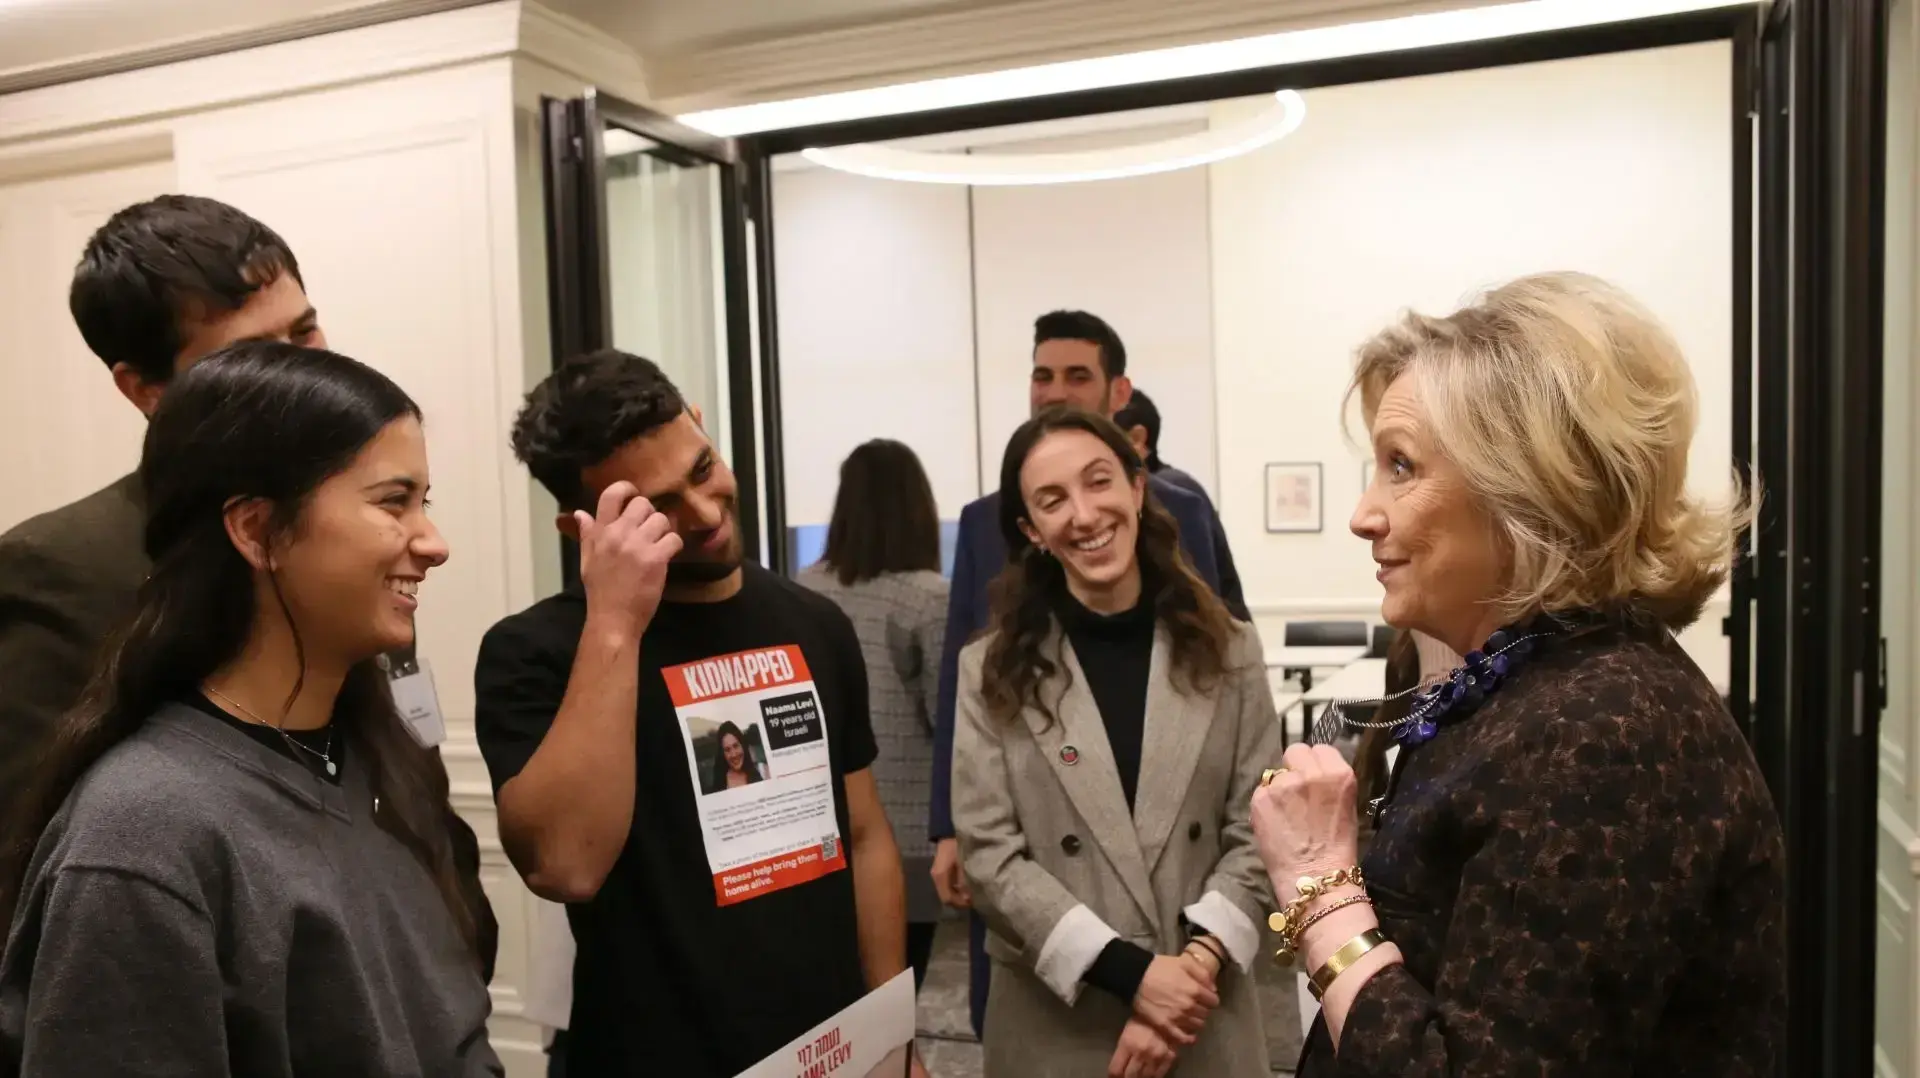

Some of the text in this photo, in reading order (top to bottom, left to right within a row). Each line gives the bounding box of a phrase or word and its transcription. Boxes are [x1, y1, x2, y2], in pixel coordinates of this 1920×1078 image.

[683, 649, 795, 699] KIDNAPPED
[765, 698, 814, 716] Naama Levi
[769, 711, 816, 728] 19 years old
[784, 724, 809, 737] Israeli
[722, 871, 752, 886] Please
[753, 865, 772, 877] help
[773, 859, 797, 872] bring
[725, 878, 774, 897] home alive.
[797, 1026, 840, 1067] נעמה לוי
[828, 1041, 852, 1072] LEVY
